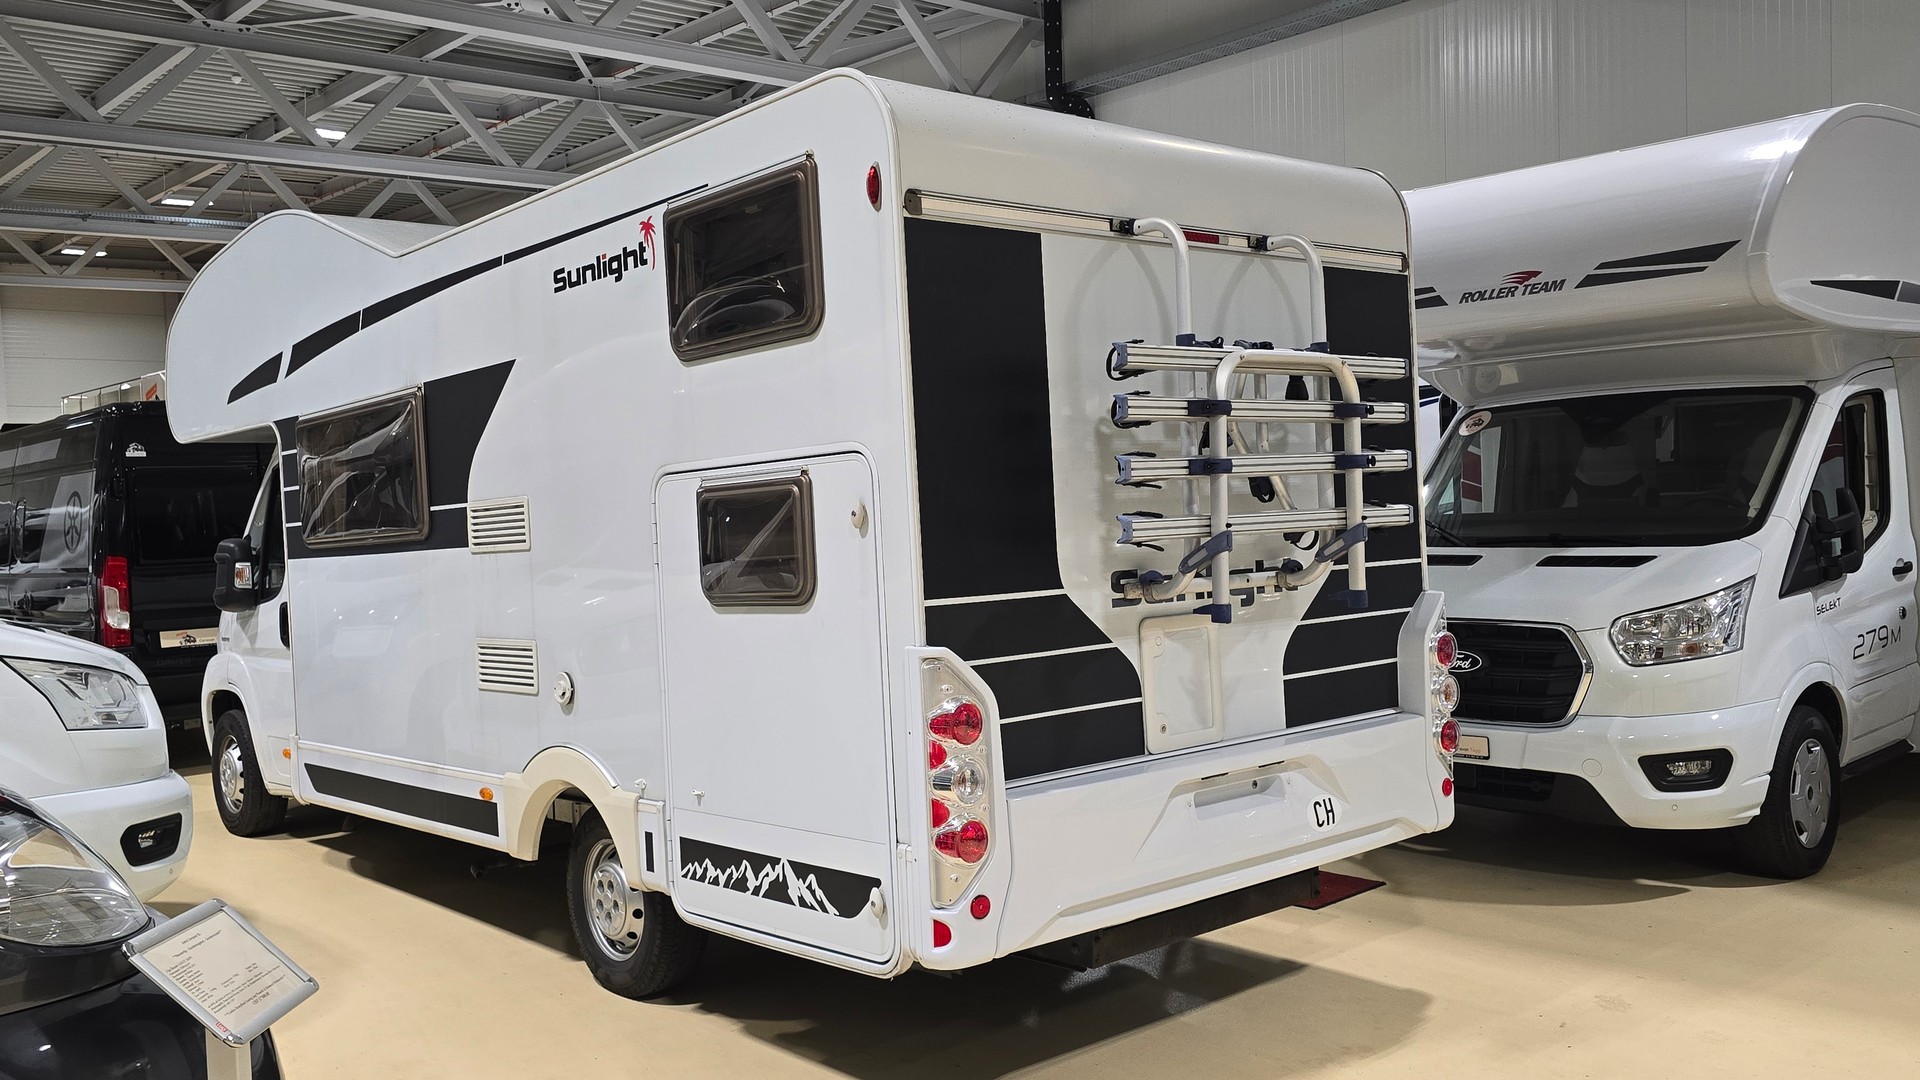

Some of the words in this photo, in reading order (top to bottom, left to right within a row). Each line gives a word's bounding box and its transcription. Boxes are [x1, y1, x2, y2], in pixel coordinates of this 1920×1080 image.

[553, 241, 648, 294] Sunlight
[1458, 285, 1519, 304] ROLLER
[1521, 278, 1567, 297] TEAM
[1816, 597, 1842, 616] SELEKT
[1313, 797, 1335, 828] CH
